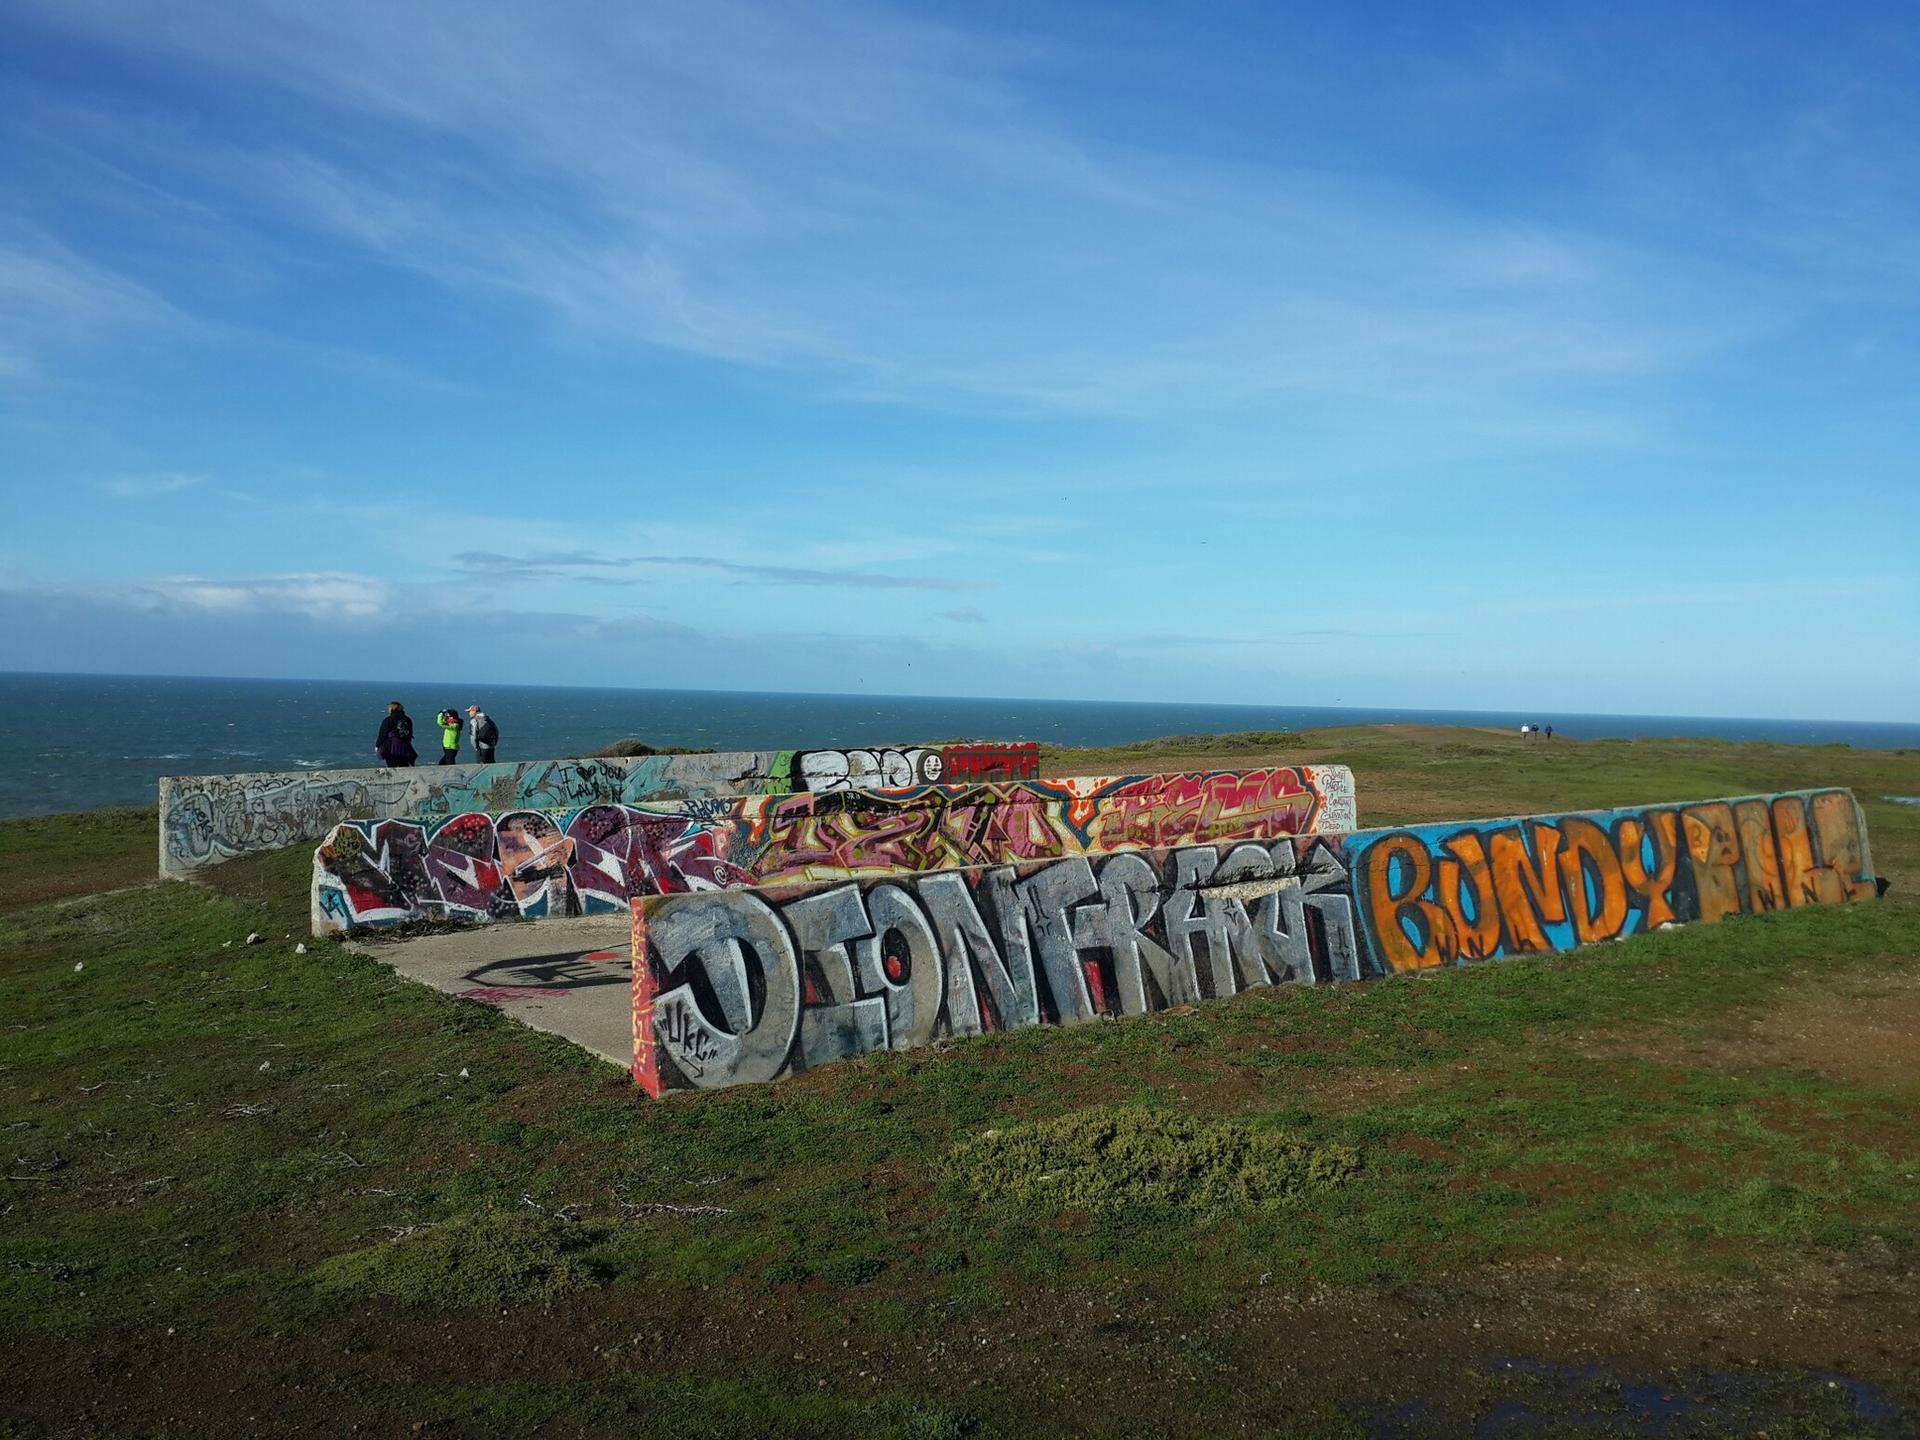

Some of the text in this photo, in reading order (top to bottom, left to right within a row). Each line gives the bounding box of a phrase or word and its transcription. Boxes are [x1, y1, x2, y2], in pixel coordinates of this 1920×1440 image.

[558, 766, 574, 784] I
[567, 777, 624, 804] LAURN
[1367, 810, 1678, 973] BUNDY
